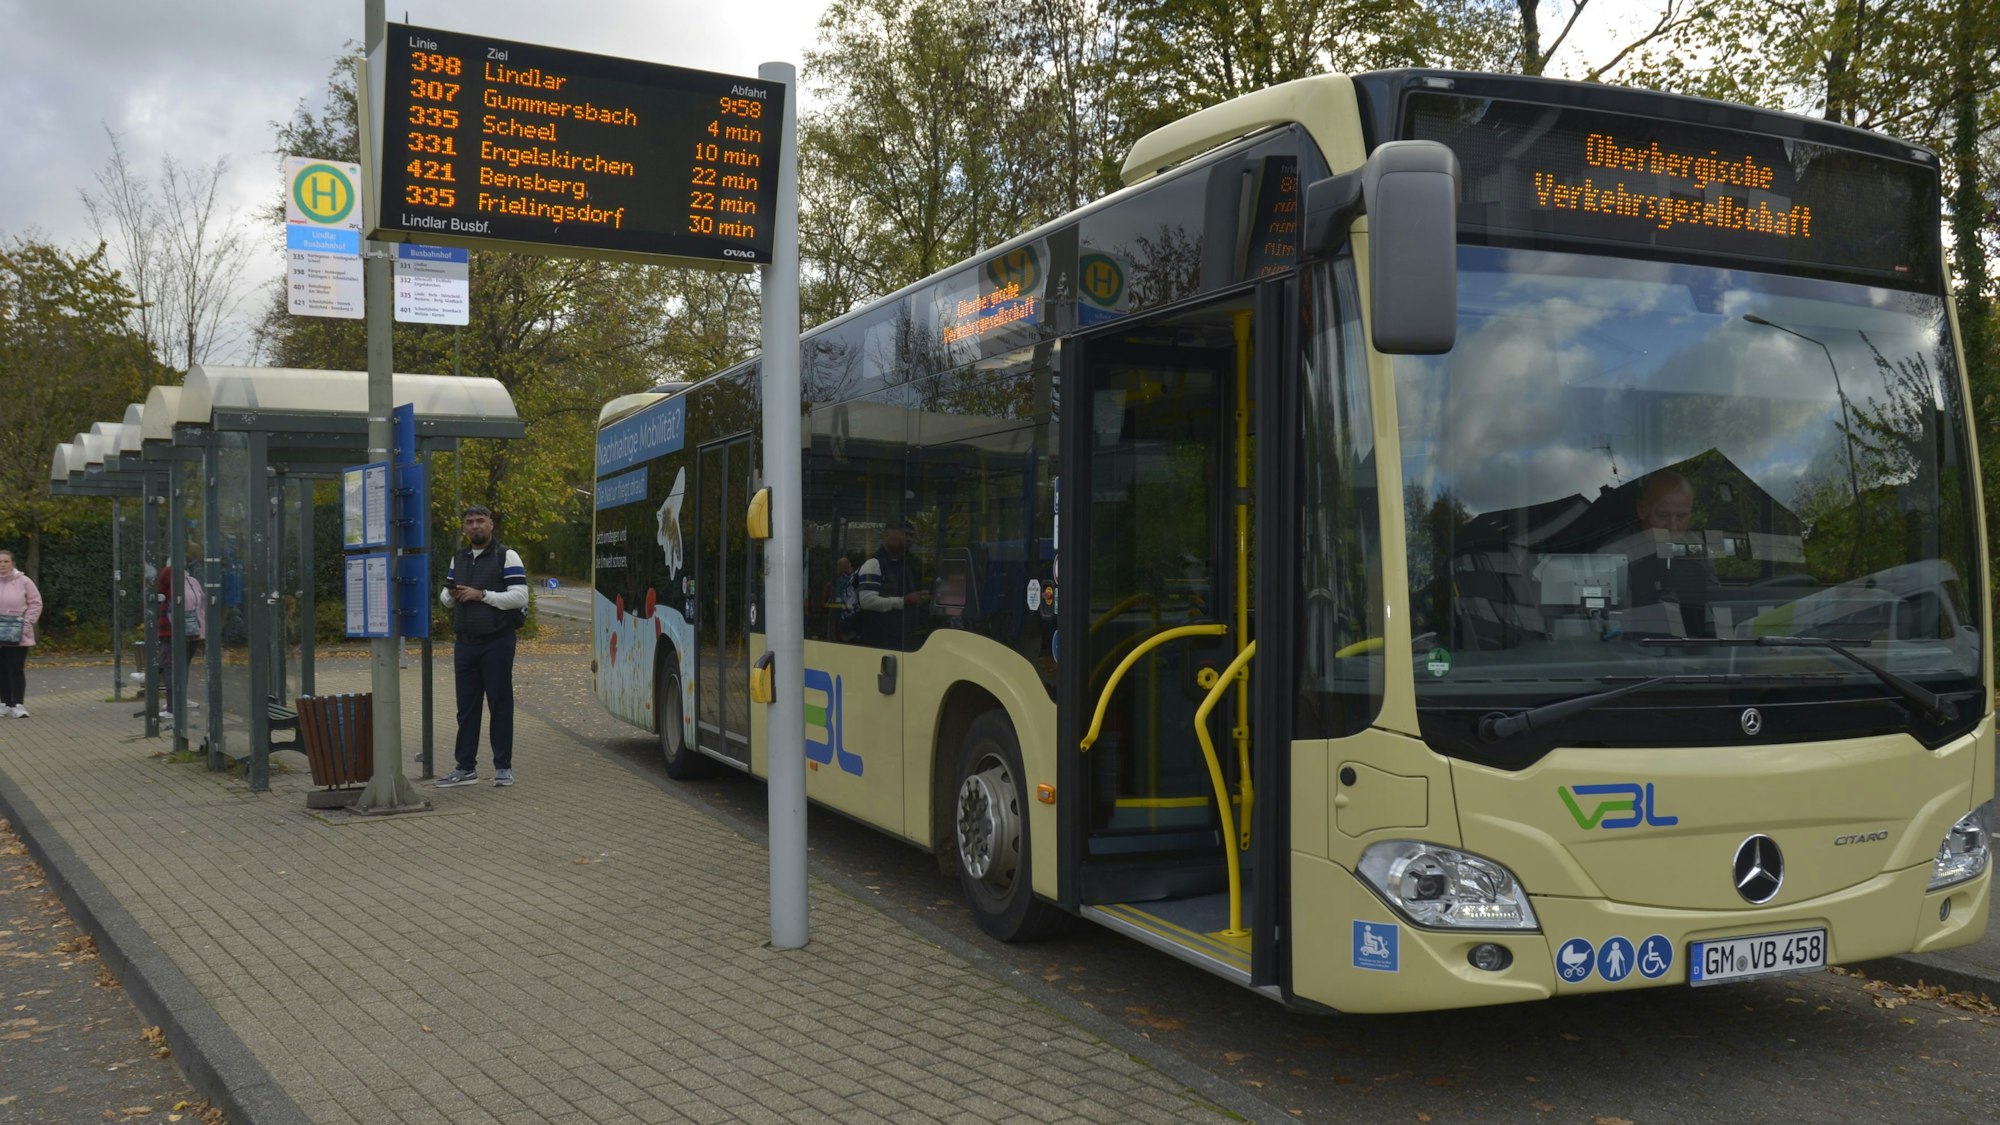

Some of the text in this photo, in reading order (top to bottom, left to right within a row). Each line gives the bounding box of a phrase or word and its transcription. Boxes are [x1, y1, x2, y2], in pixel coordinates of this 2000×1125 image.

[409, 36, 767, 99] Linie Ziel Abfahrt
[411, 52, 763, 119] 398 Lindlar 9:58
[409, 105, 760, 167] 335 Scheel 10 min
[410, 78, 762, 143] 307 Gummersbach 4 min
[406, 159, 756, 215] 421 Bensberg 22 min
[408, 132, 758, 191] 331 Engelskirchen 22 min
[1587, 133, 1774, 190] Oberbergische
[311, 175, 337, 212] H
[405, 185, 755, 238] 335 Frielingsdorf 30 min
[1535, 172, 1812, 239] Verkehrsgesellschaft
[402, 213, 492, 234] Lindlar Busbf.
[410, 249, 452, 259] Busbahnhof
[723, 248, 756, 259] OVAG
[599, 407, 681, 466] Nachhaltige Mobilität?
[804, 668, 864, 777] BL
[1557, 782, 1679, 831] VBL
[1834, 831, 1889, 846] CITARO
[1693, 966, 1700, 975] D
[1705, 936, 1821, 975] GM VB 458
